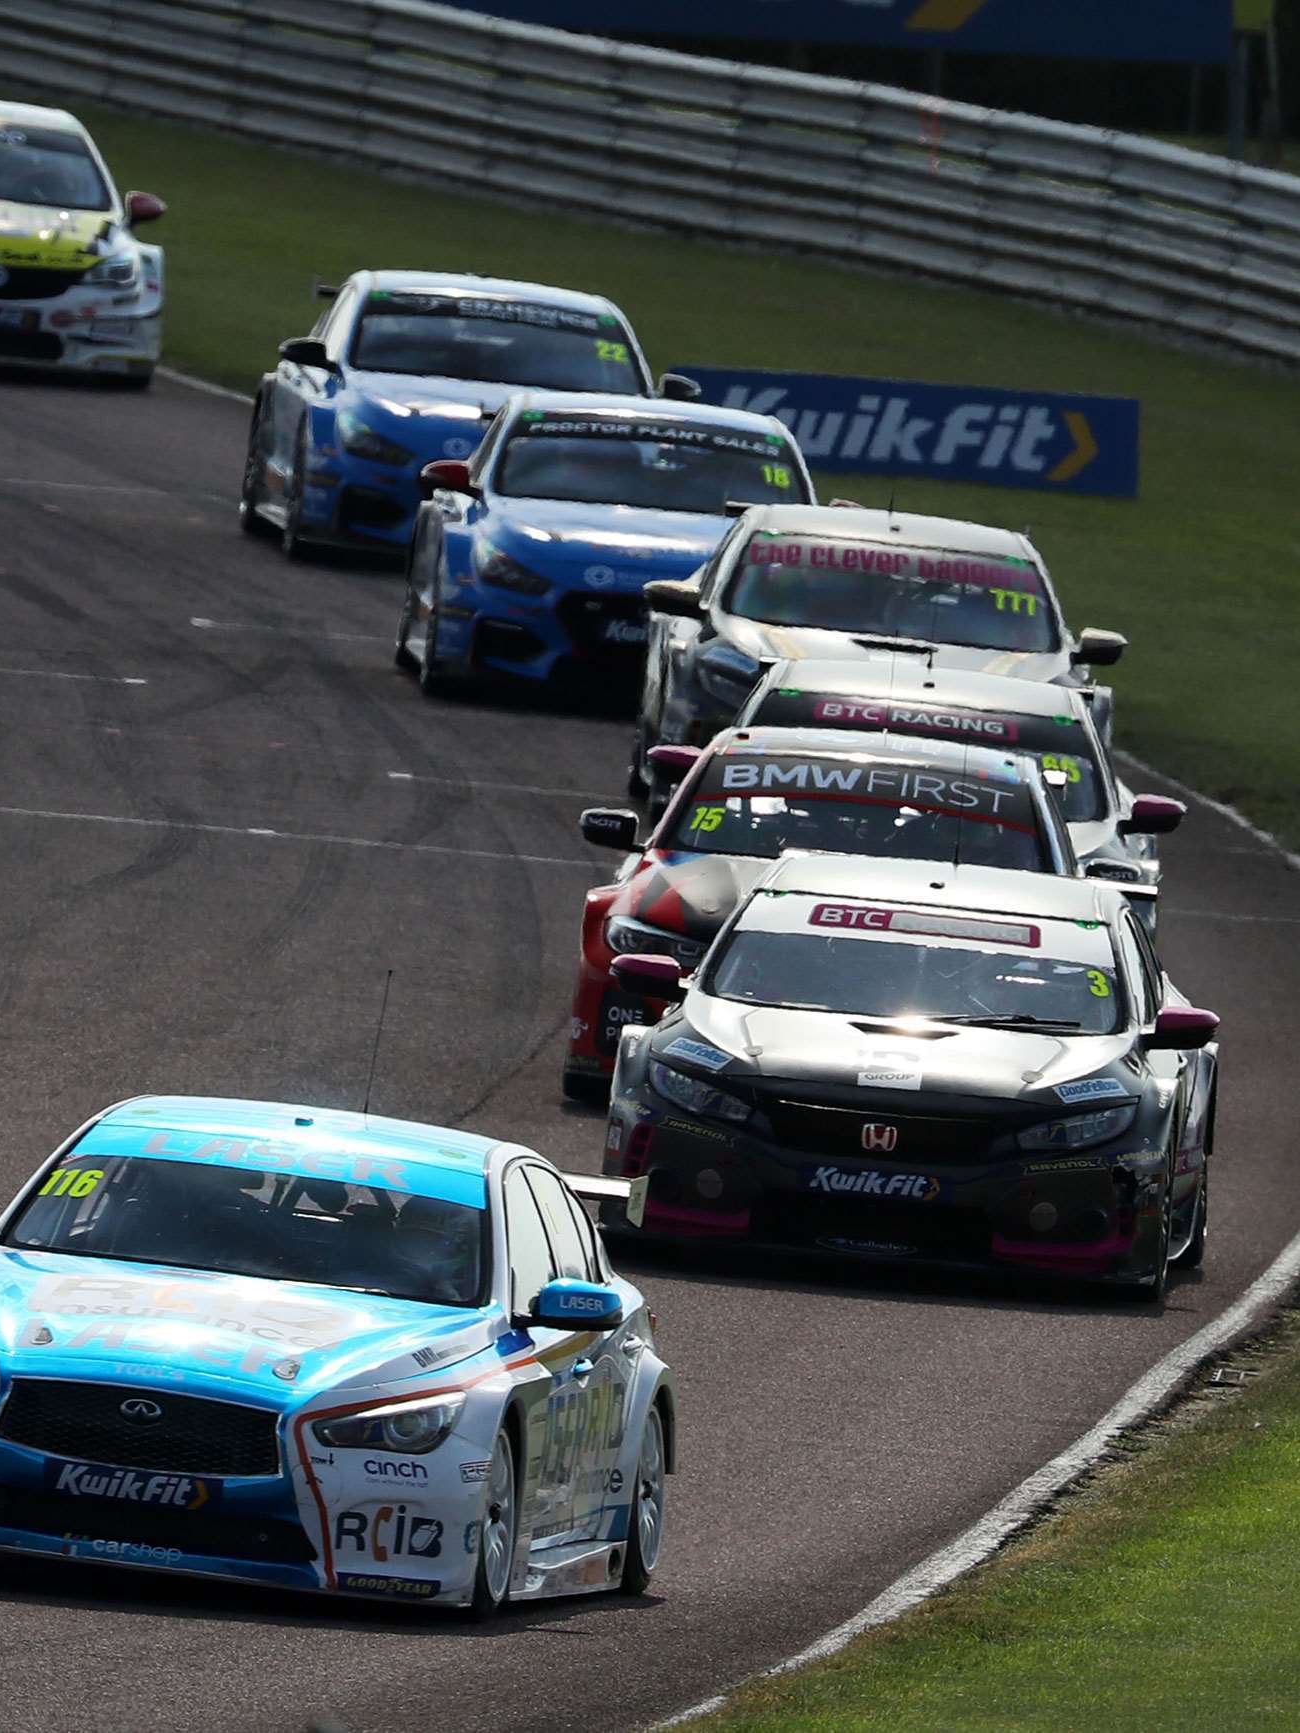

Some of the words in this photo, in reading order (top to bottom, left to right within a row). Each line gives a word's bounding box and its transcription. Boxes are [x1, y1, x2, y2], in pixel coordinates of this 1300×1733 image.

[595, 340, 629, 364] 22
[639, 426, 707, 442] PLANT
[761, 464, 791, 489] 18
[988, 587, 1037, 616] 777
[822, 702, 884, 722] BTC
[889, 709, 1005, 737] RACING
[688, 806, 728, 833] 15
[818, 906, 888, 928] BTC
[1086, 969, 1110, 997] 3
[607, 1005, 645, 1025] ONE
[144, 1133, 411, 1188] LASER
[38, 1168, 105, 1199] 116
[560, 1295, 605, 1313] LASER
[363, 1458, 429, 1479] cinch
[92, 1538, 183, 1565] carshop
[347, 1576, 434, 1595] GOODYEAR
